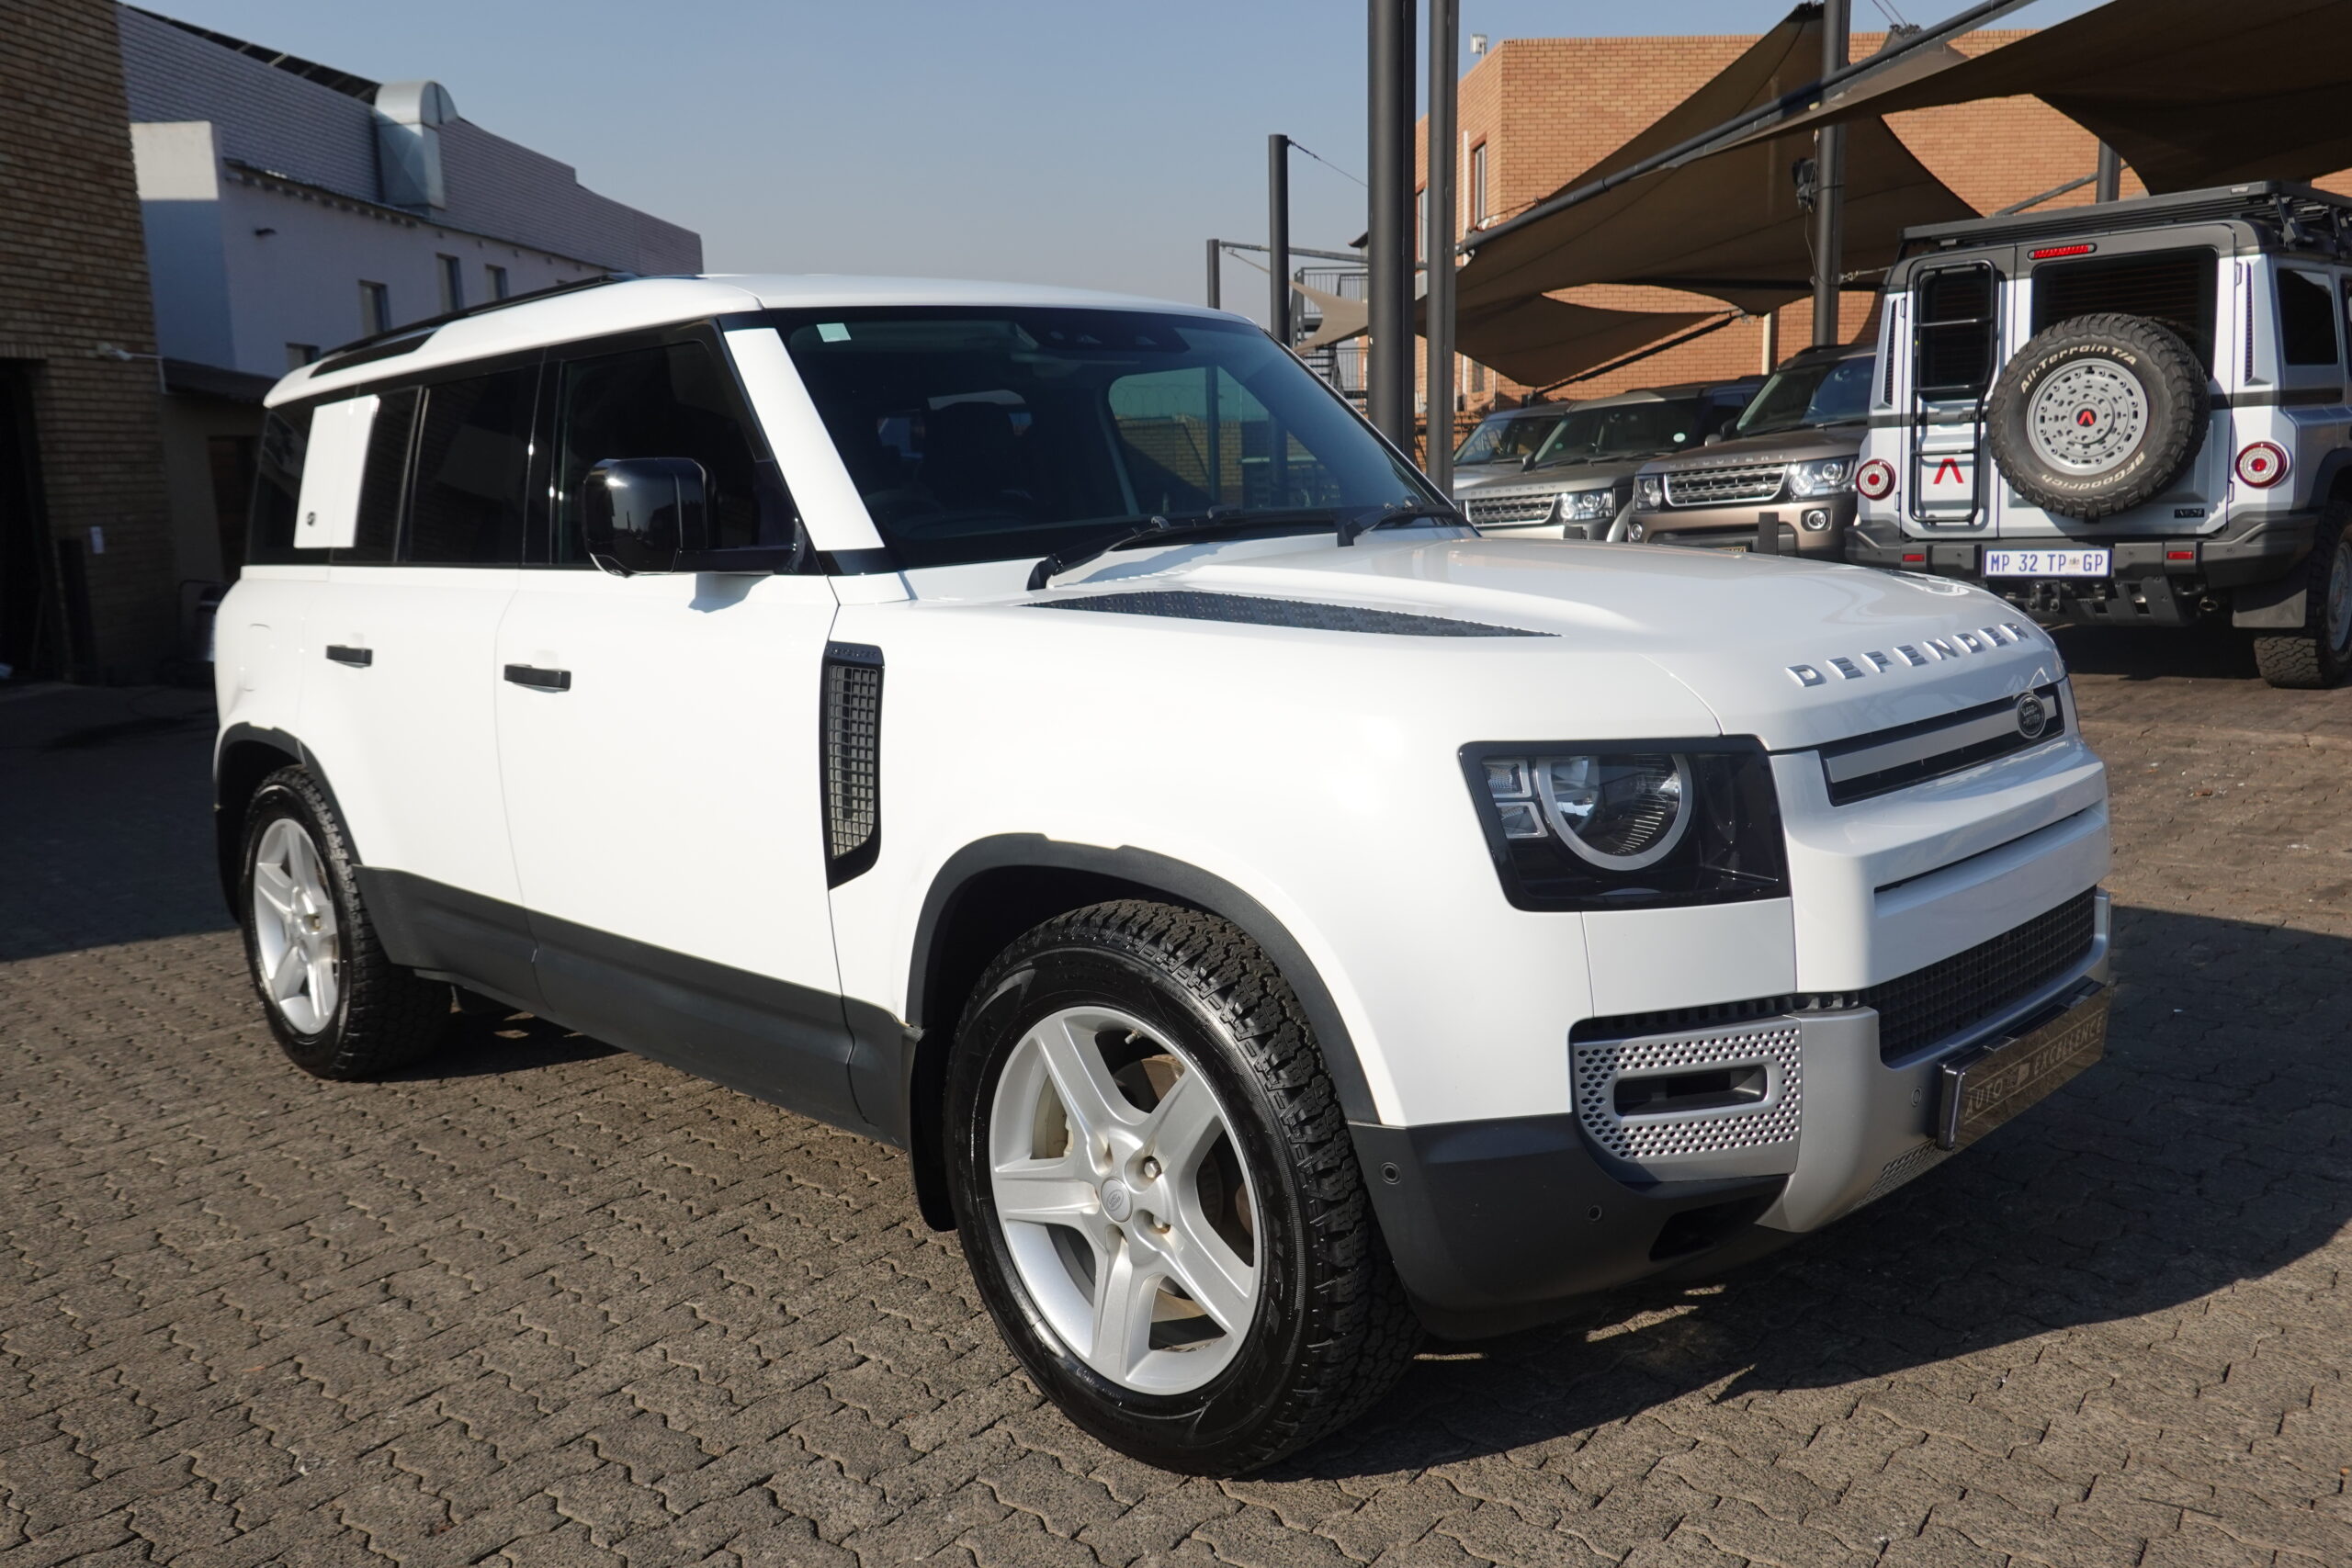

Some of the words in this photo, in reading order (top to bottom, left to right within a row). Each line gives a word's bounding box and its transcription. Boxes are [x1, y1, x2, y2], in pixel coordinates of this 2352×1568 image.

[2020, 344, 2109, 393] All-Terrain
[2110, 347, 2137, 366] T/A
[2041, 452, 2146, 491] BFGoodrich
[1990, 554, 2010, 572] MP
[2018, 554, 2038, 572] 32
[2047, 554, 2066, 571] TP
[2083, 554, 2104, 571] GP
[1785, 622, 2029, 687] DEFENDER
[1964, 1078, 2004, 1118] AUTO
[2033, 1015, 2103, 1076] EXCELLENCE
